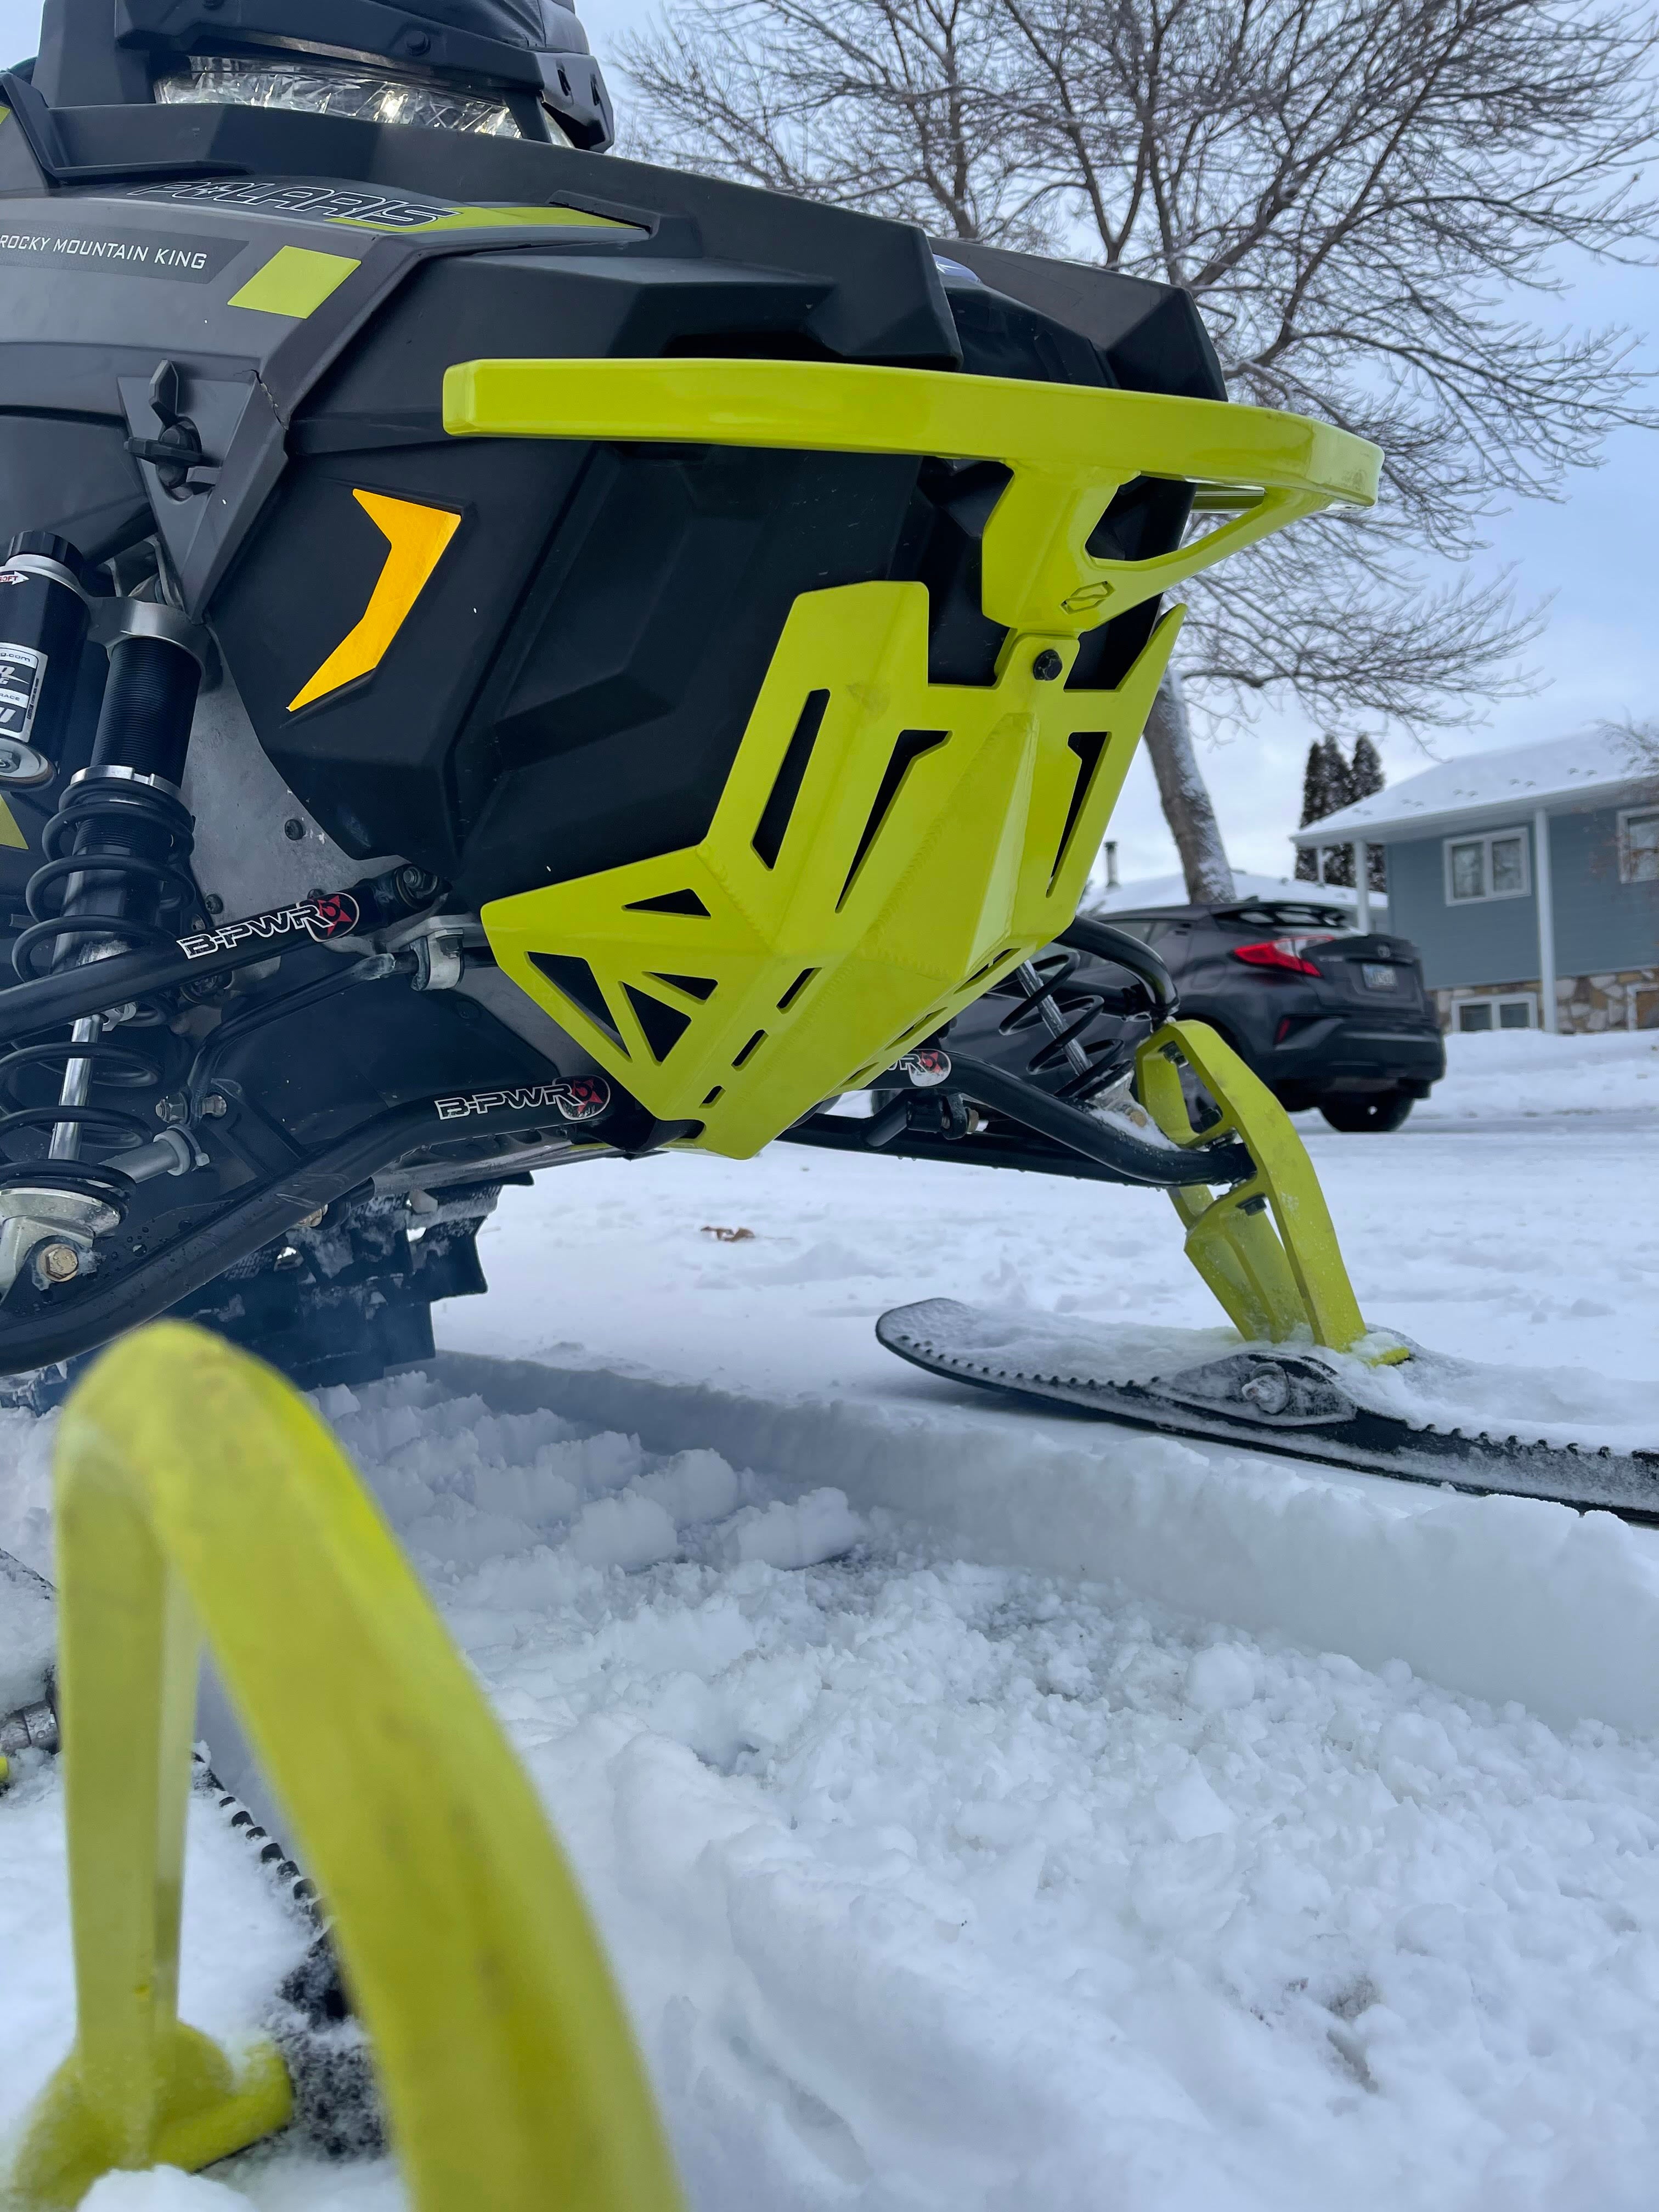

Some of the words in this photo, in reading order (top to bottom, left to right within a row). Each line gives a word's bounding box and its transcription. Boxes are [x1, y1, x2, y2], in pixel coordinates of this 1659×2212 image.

[127, 181, 464, 227] POLARIS
[0, 235, 50, 251] ROCKY
[53, 238, 149, 262] MOUNTAIN
[154, 249, 207, 269] KING
